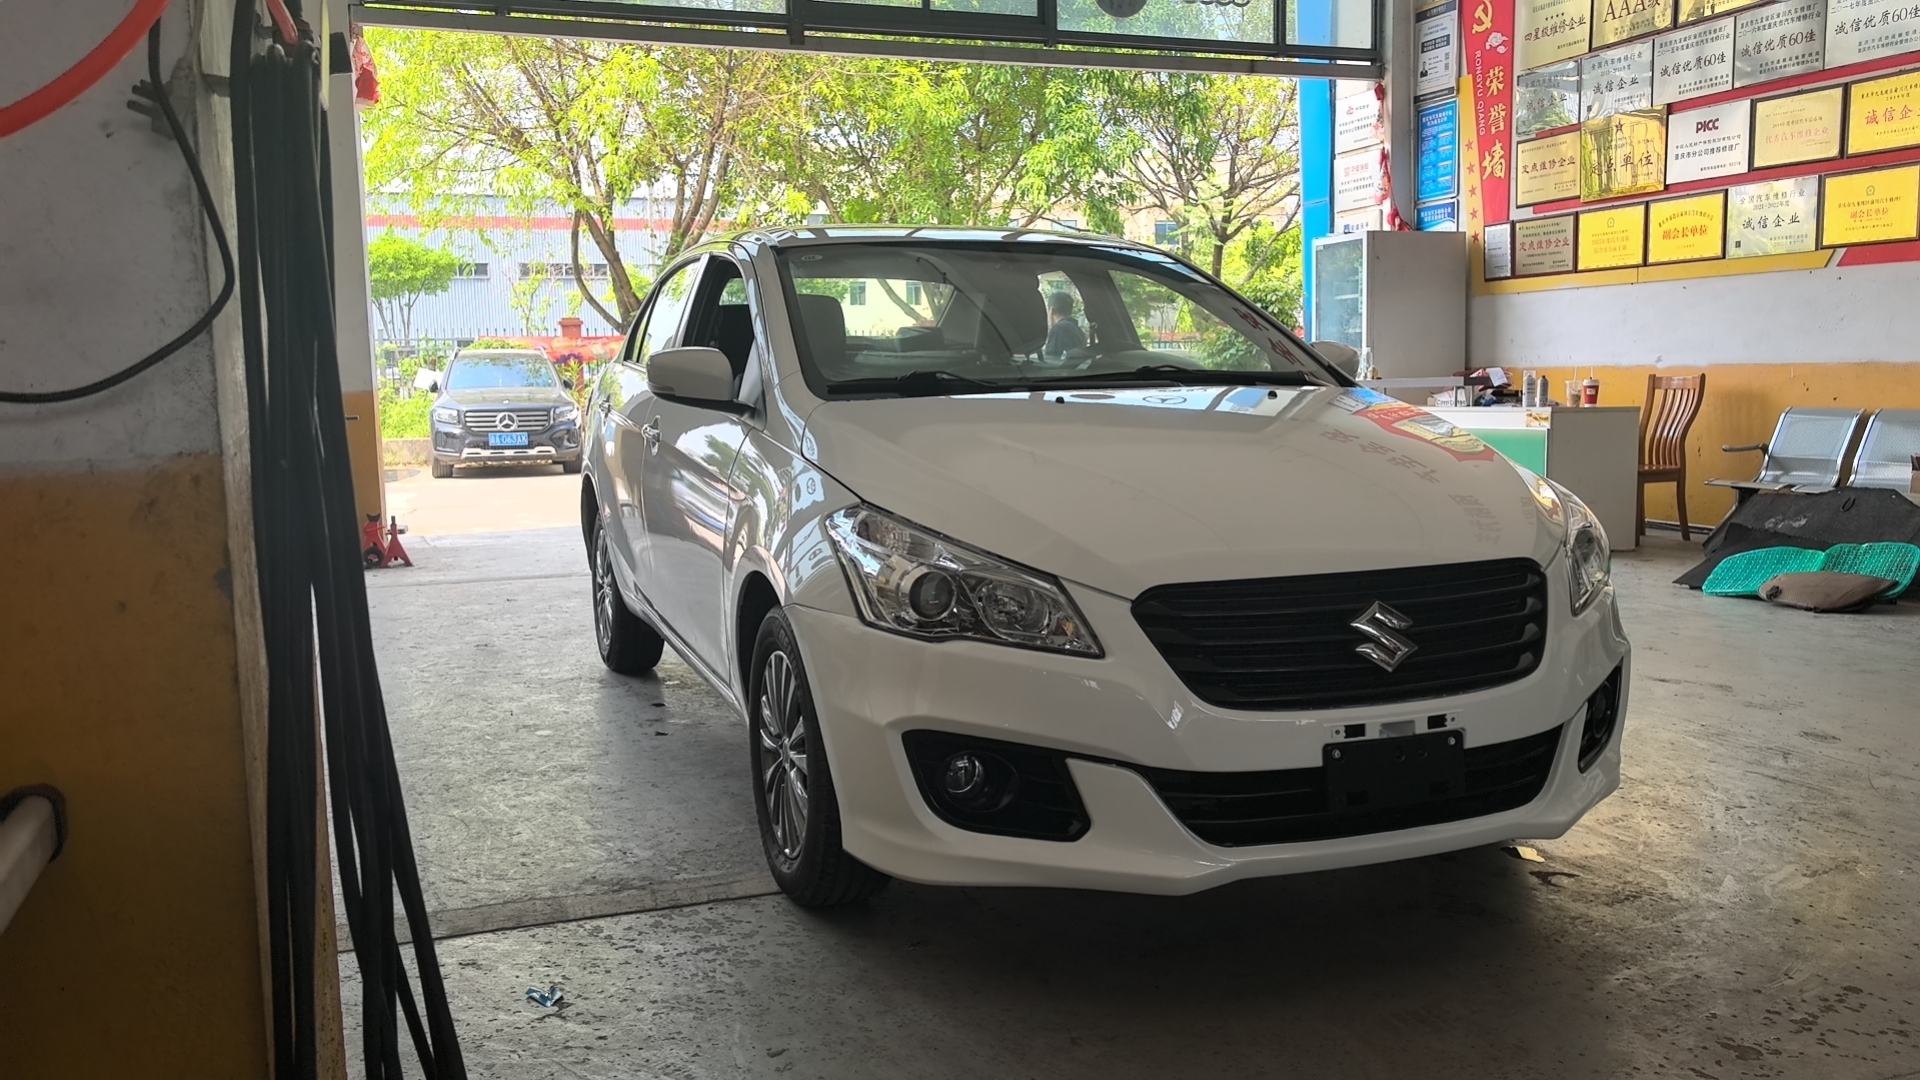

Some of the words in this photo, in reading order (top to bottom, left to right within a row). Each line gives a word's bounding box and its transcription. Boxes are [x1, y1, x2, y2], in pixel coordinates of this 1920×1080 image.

[1524, 14, 1586, 42] 四星级维修企业
[1835, 5, 1920, 35] 诚信优质60佳
[1741, 29, 1816, 58] 诚信优质60佳
[1475, 50, 1484, 97] RONGYU
[1660, 51, 1727, 77] 诚信优质60佳
[1593, 75, 1639, 95] 诚信企业
[1477, 101, 1486, 136] QIANG
[1481, 66, 1506, 180] 荣誉墙
[1696, 118, 1719, 133] PICC
[1865, 104, 1920, 125] 诚信企
[1590, 150, 1653, 177] 定点单位
[1740, 189, 1805, 205] 全国汽车维修行业
[1742, 213, 1800, 231] 诚信企业
[1850, 207, 1889, 219] 副会长单位
[1662, 225, 1708, 240] 副会长单位
